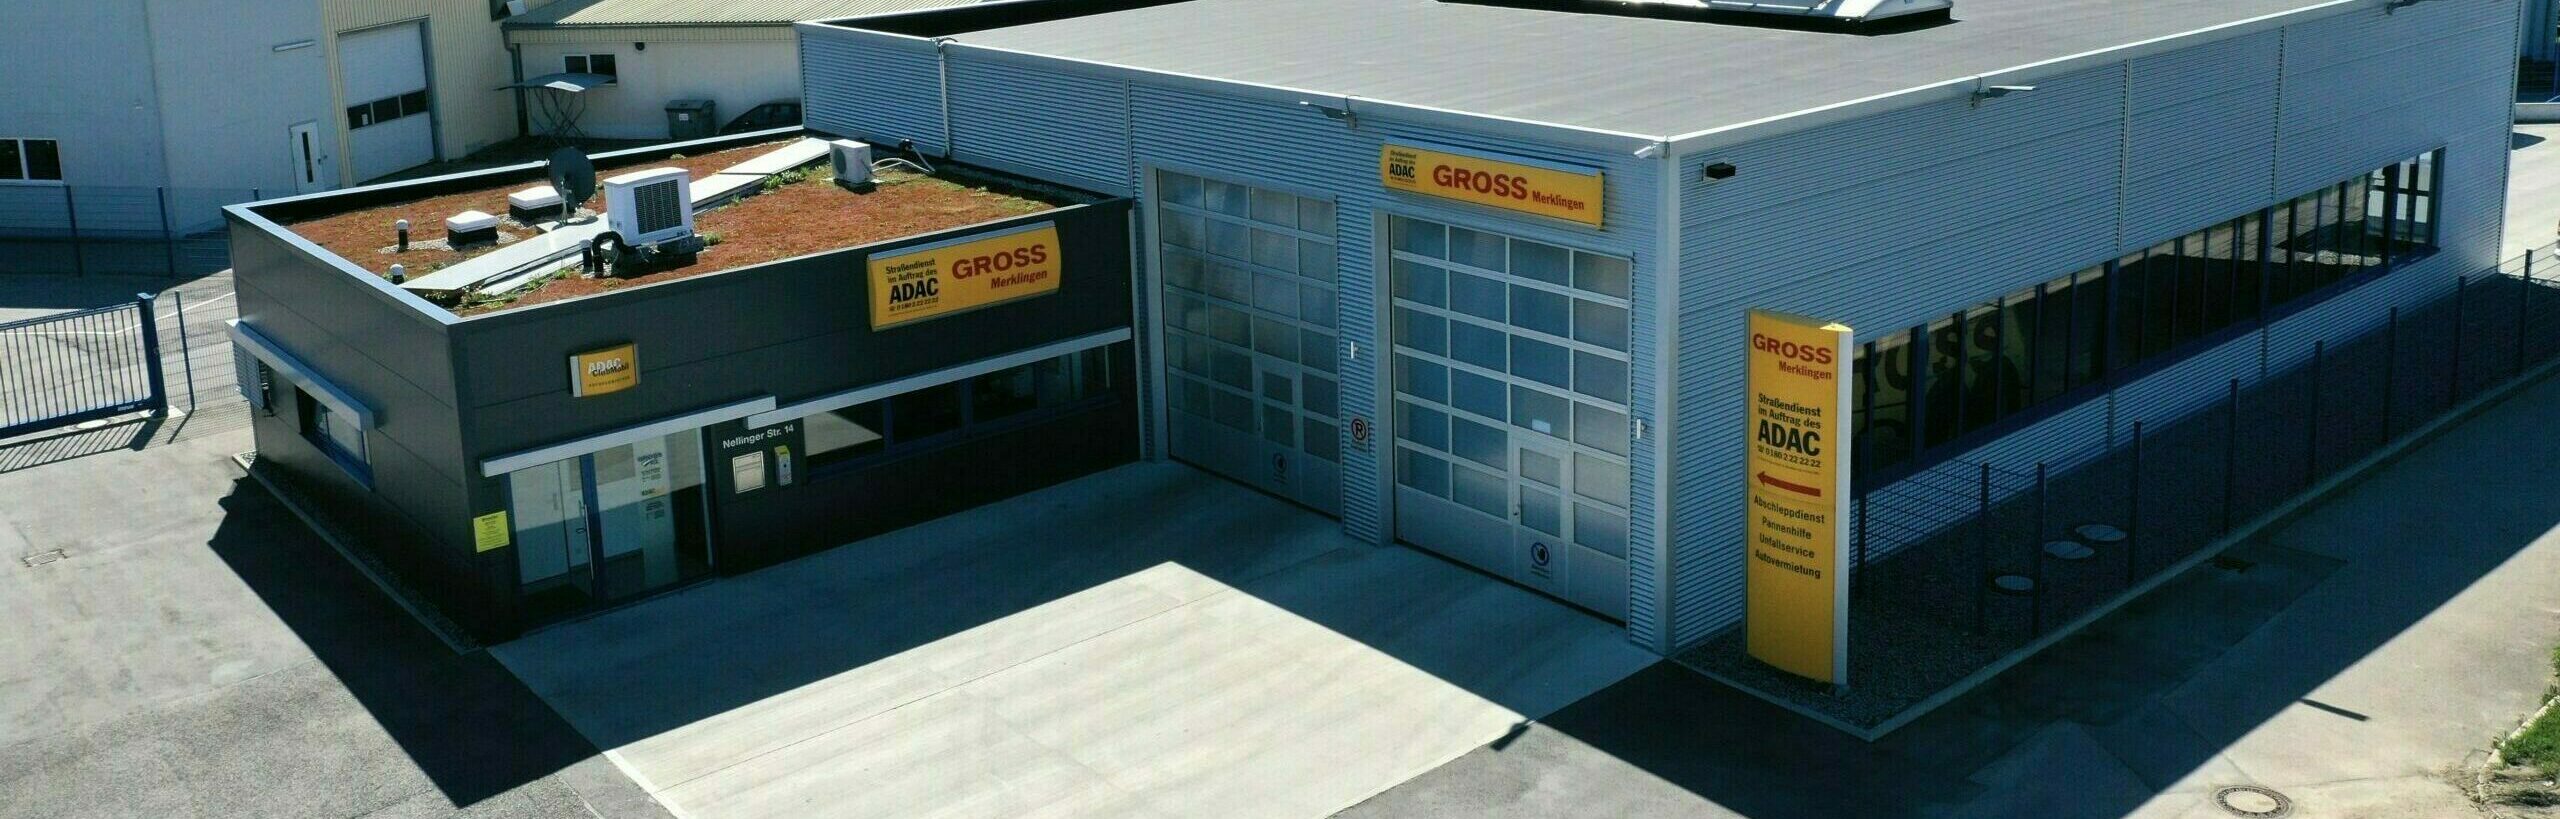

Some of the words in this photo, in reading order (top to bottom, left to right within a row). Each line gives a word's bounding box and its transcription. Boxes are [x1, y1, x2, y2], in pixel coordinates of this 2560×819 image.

[1390, 163, 1415, 178] ADAC
[1433, 164, 1528, 200] GROSS
[1532, 191, 1585, 211] Merklingen
[886, 258, 936, 275] Straßendienst
[952, 244, 1047, 280] GROSS
[898, 271, 925, 282] Auftrag
[926, 268, 938, 278] des
[991, 270, 1048, 289] Merklingen
[890, 278, 939, 304] ADAC
[1753, 333, 1832, 364] GROSS
[588, 358, 622, 374] ADAC
[1779, 361, 1832, 380] Merklingen
[1758, 393, 1821, 417] Straßendienst
[1758, 404, 1767, 416] im
[1768, 409, 1801, 427] Auftrag
[1804, 417, 1821, 430] des
[766, 428, 782, 438] Str.
[784, 424, 794, 434] 14
[1758, 418, 1820, 456] ADAC
[1754, 494, 1825, 524] Abschleppdienst
[1762, 516, 1812, 540] Pannenhilfe
[1760, 532, 1814, 558] Unfallservice
[1755, 549, 1821, 579] Autovermietung
